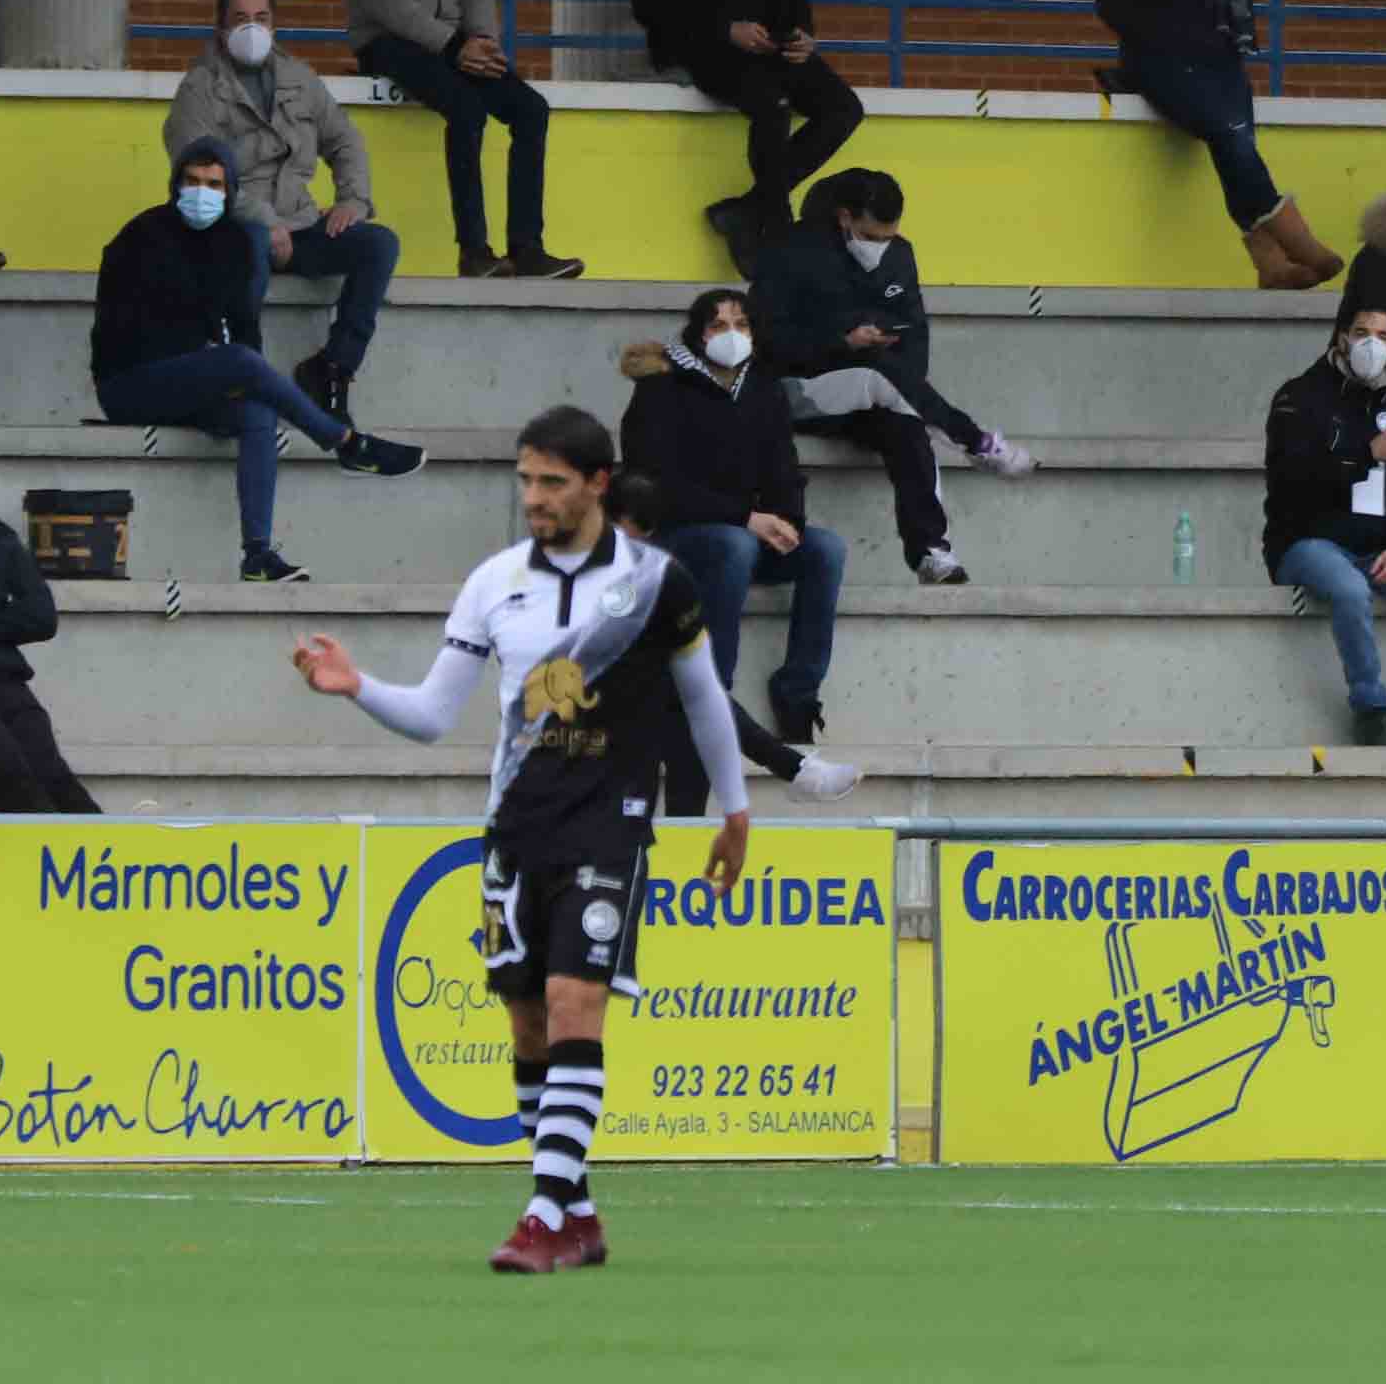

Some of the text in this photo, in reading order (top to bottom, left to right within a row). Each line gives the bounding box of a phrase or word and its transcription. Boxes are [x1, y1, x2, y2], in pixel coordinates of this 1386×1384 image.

[40, 842, 348, 927] Mármoles y
[644, 867, 886, 931] RQUÍDEA
[124, 944, 345, 1011] Granitos
[396, 955, 497, 1027] Orqu
[630, 978, 859, 1019] restaurante
[1028, 921, 1327, 1087] ÁNGEL MARTÍN
[145, 1048, 355, 1139] Charro
[653, 1064, 837, 1096] 923 22 65 41
[602, 1111, 652, 1134] Calle
[718, 1111, 730, 1134] 3
[747, 1111, 876, 1134] SALAMANCA
